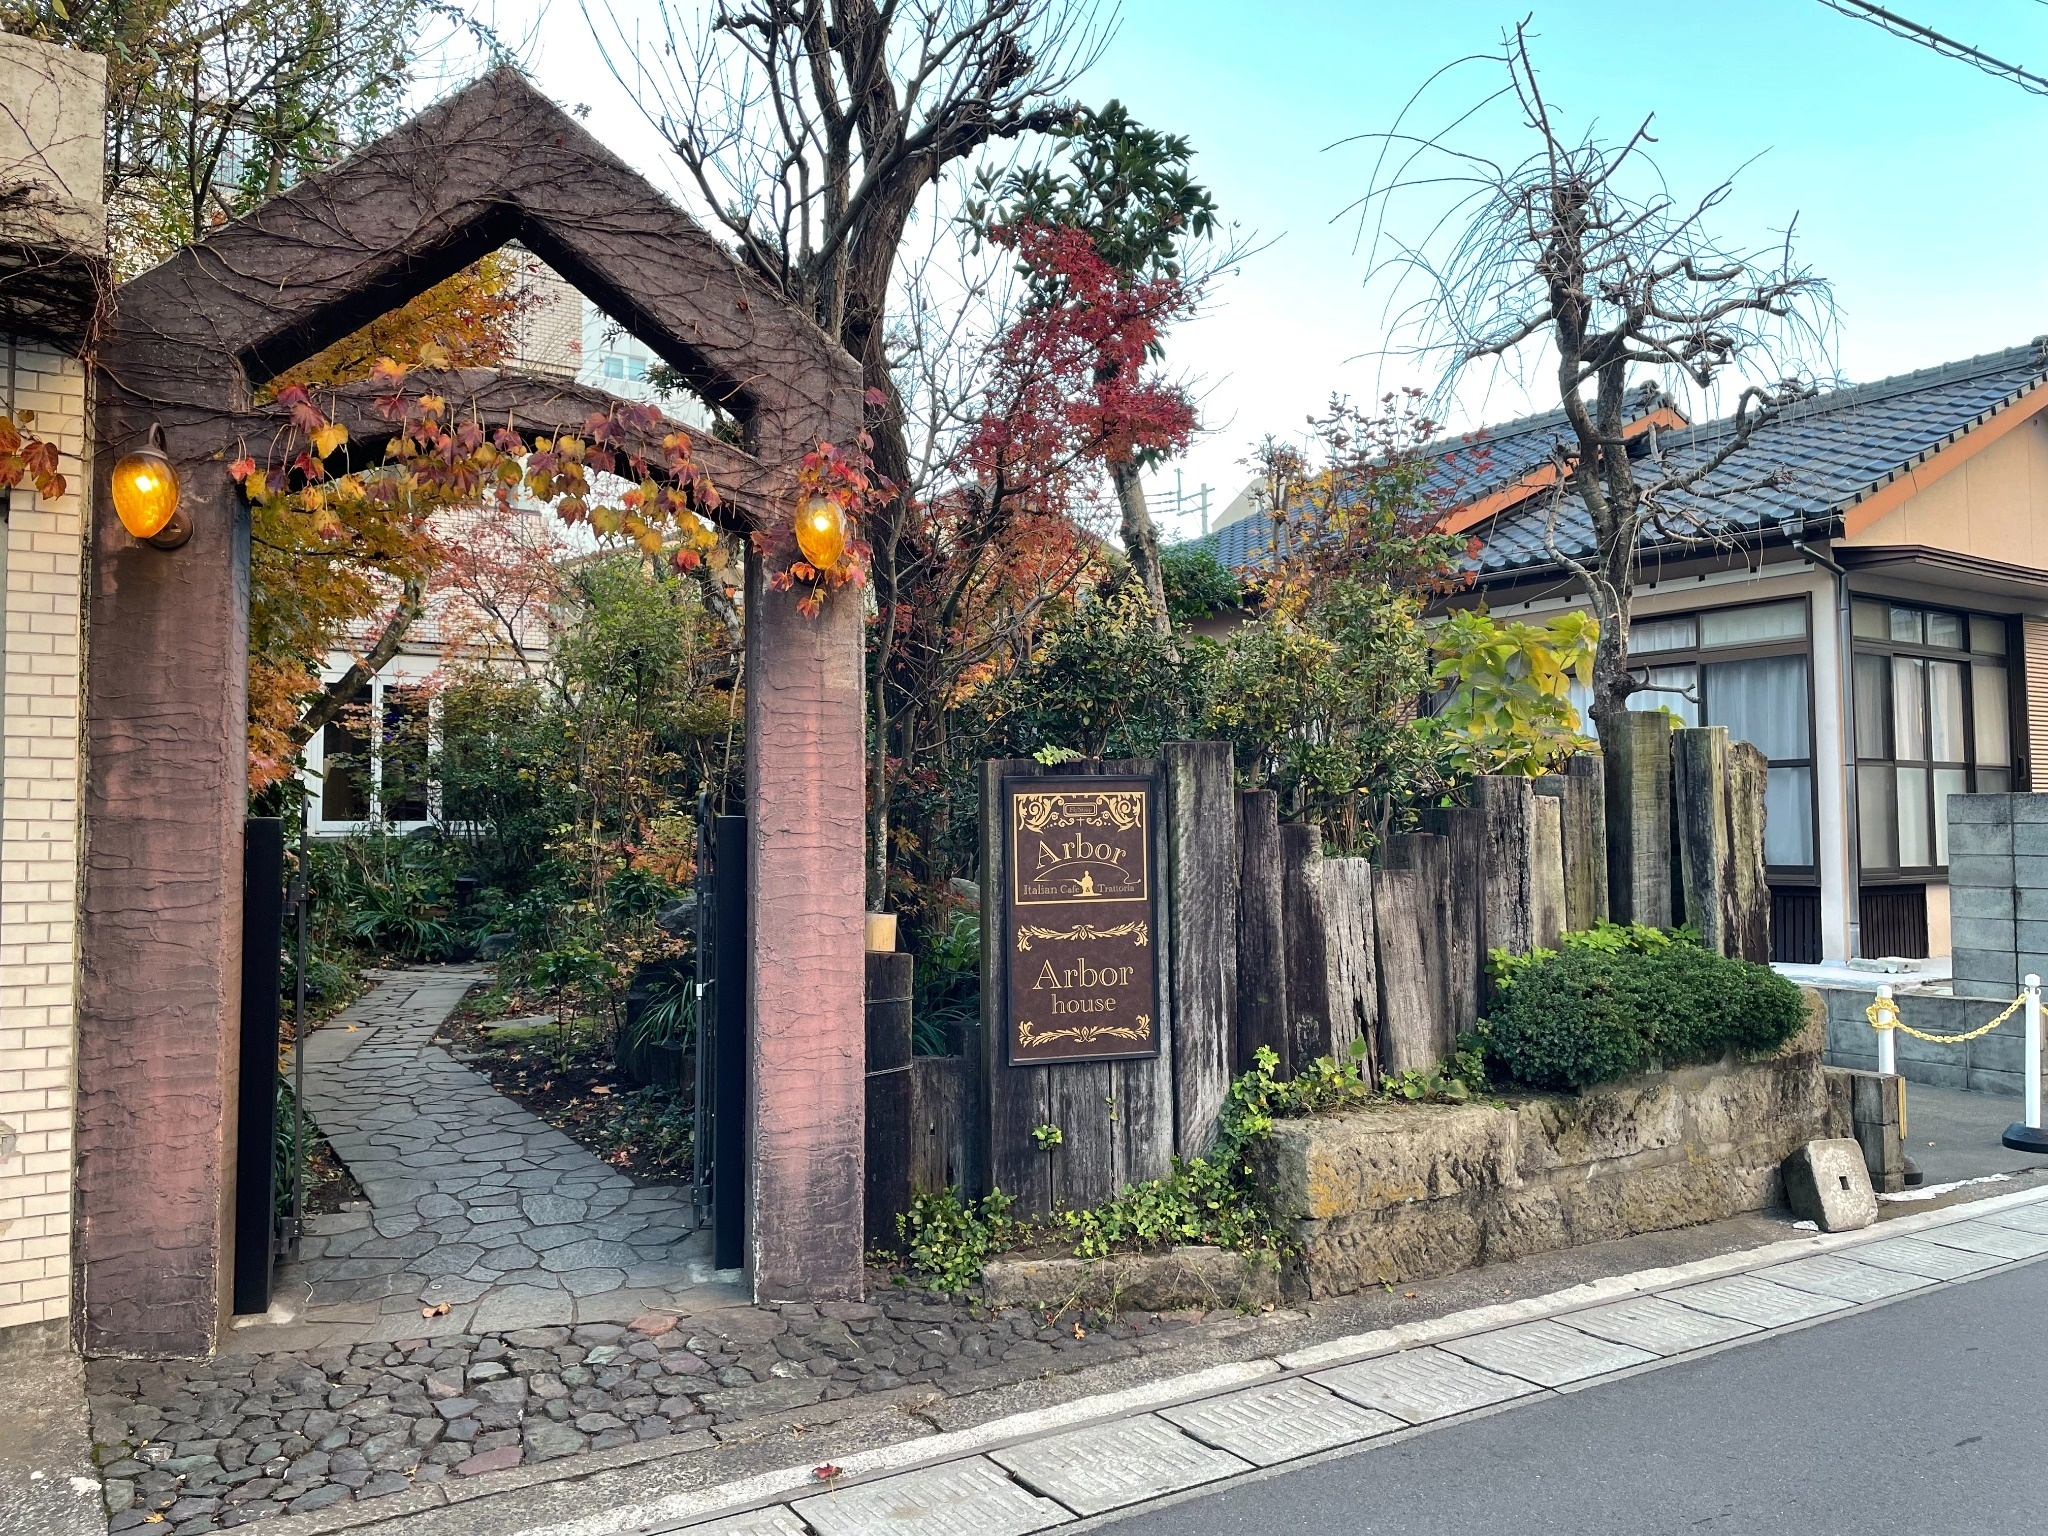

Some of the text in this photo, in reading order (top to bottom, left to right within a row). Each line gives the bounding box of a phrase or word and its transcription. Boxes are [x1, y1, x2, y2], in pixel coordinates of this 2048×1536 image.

[1035, 832, 1127, 870] Arbor
[1023, 884, 1058, 896] Italian
[1097, 883, 1135, 893] Trattoria
[1032, 957, 1134, 990] Arbor
[1051, 993, 1117, 1015] house
